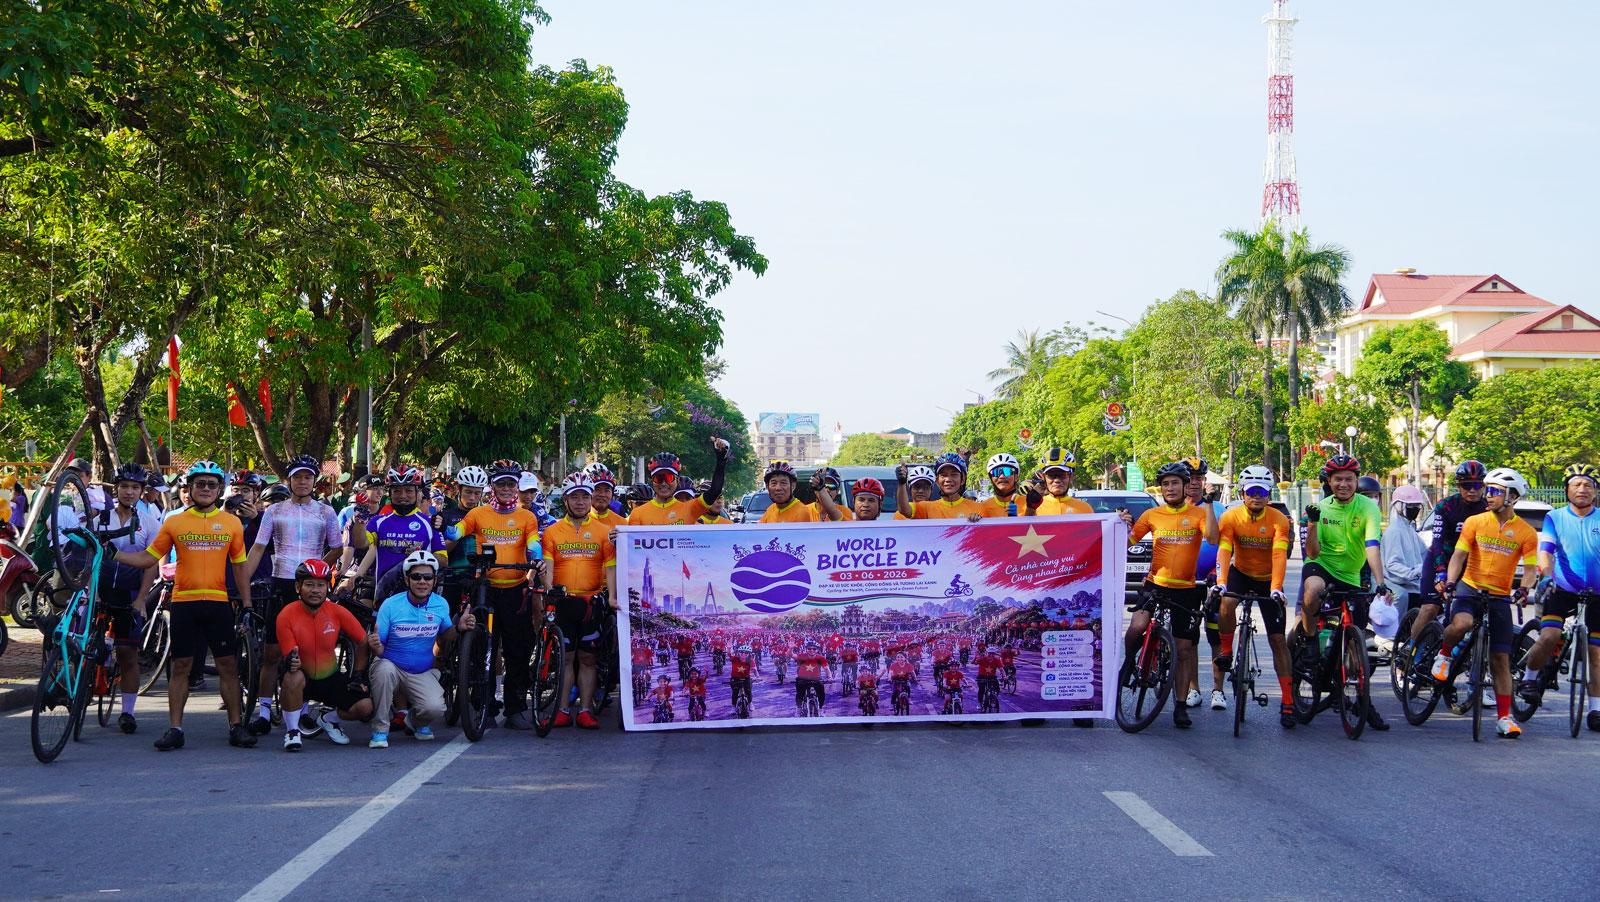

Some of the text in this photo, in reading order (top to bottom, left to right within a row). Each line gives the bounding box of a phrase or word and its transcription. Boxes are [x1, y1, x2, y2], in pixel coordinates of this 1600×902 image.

[642, 538, 674, 549] UCI
[836, 537, 897, 552] WORLD
[816, 550, 942, 570] BICYCLE DAY
[1020, 562, 1038, 571] nhà
[1040, 559, 1059, 568] cùng
[1061, 554, 1075, 563] vui
[840, 572, 852, 580] 03
[883, 570, 908, 579] 2026
[1011, 561, 1088, 583] Cùng nhau đạp xe!
